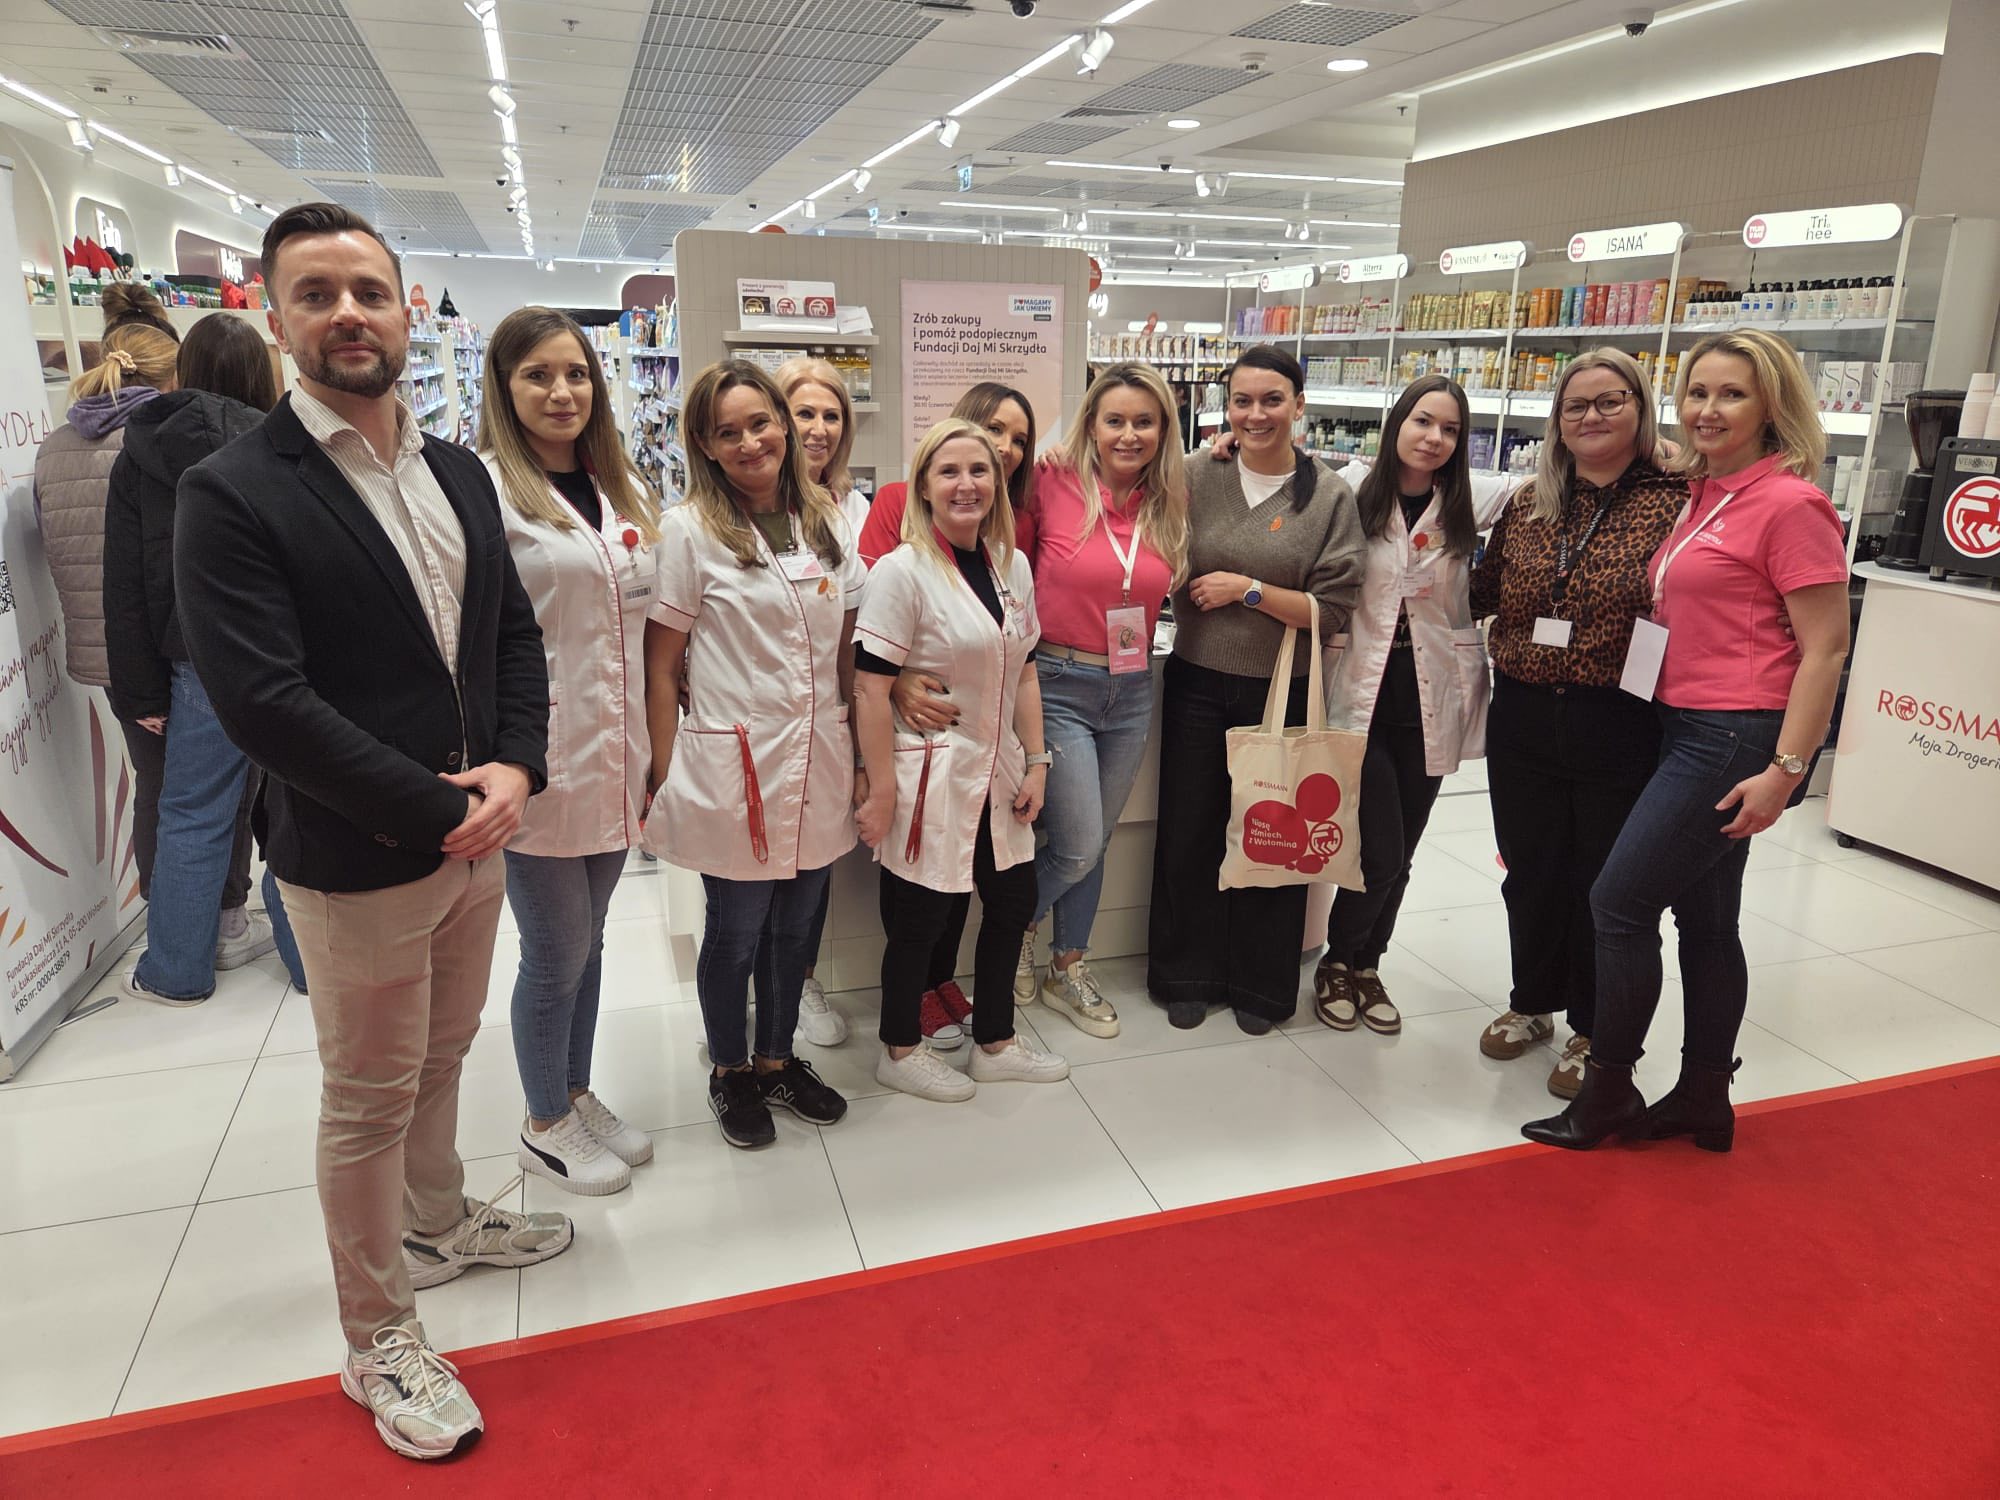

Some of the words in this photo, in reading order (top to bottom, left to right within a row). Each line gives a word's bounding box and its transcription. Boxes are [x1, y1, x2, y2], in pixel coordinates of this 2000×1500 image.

[913, 313, 938, 324] Zrób
[941, 313, 981, 327] zakupy
[913, 328, 916, 338] i
[920, 328, 956, 340] pomóż
[959, 328, 1038, 341] podopiecznym
[913, 342, 959, 355] Fundacji
[962, 343, 980, 355] Daj
[984, 343, 996, 353] Mi
[999, 343, 1047, 355] Skrzydła
[0, 408, 51, 448] YDŁA
[1908, 732, 1942, 757] Moja
[1945, 740, 2000, 770] Drogeri
[18, 949, 57, 990] Łukasiewicza
[68, 913, 88, 940] 05-200
[6, 950, 34, 982] Fundacja
[14, 995, 29, 1015] KRS
